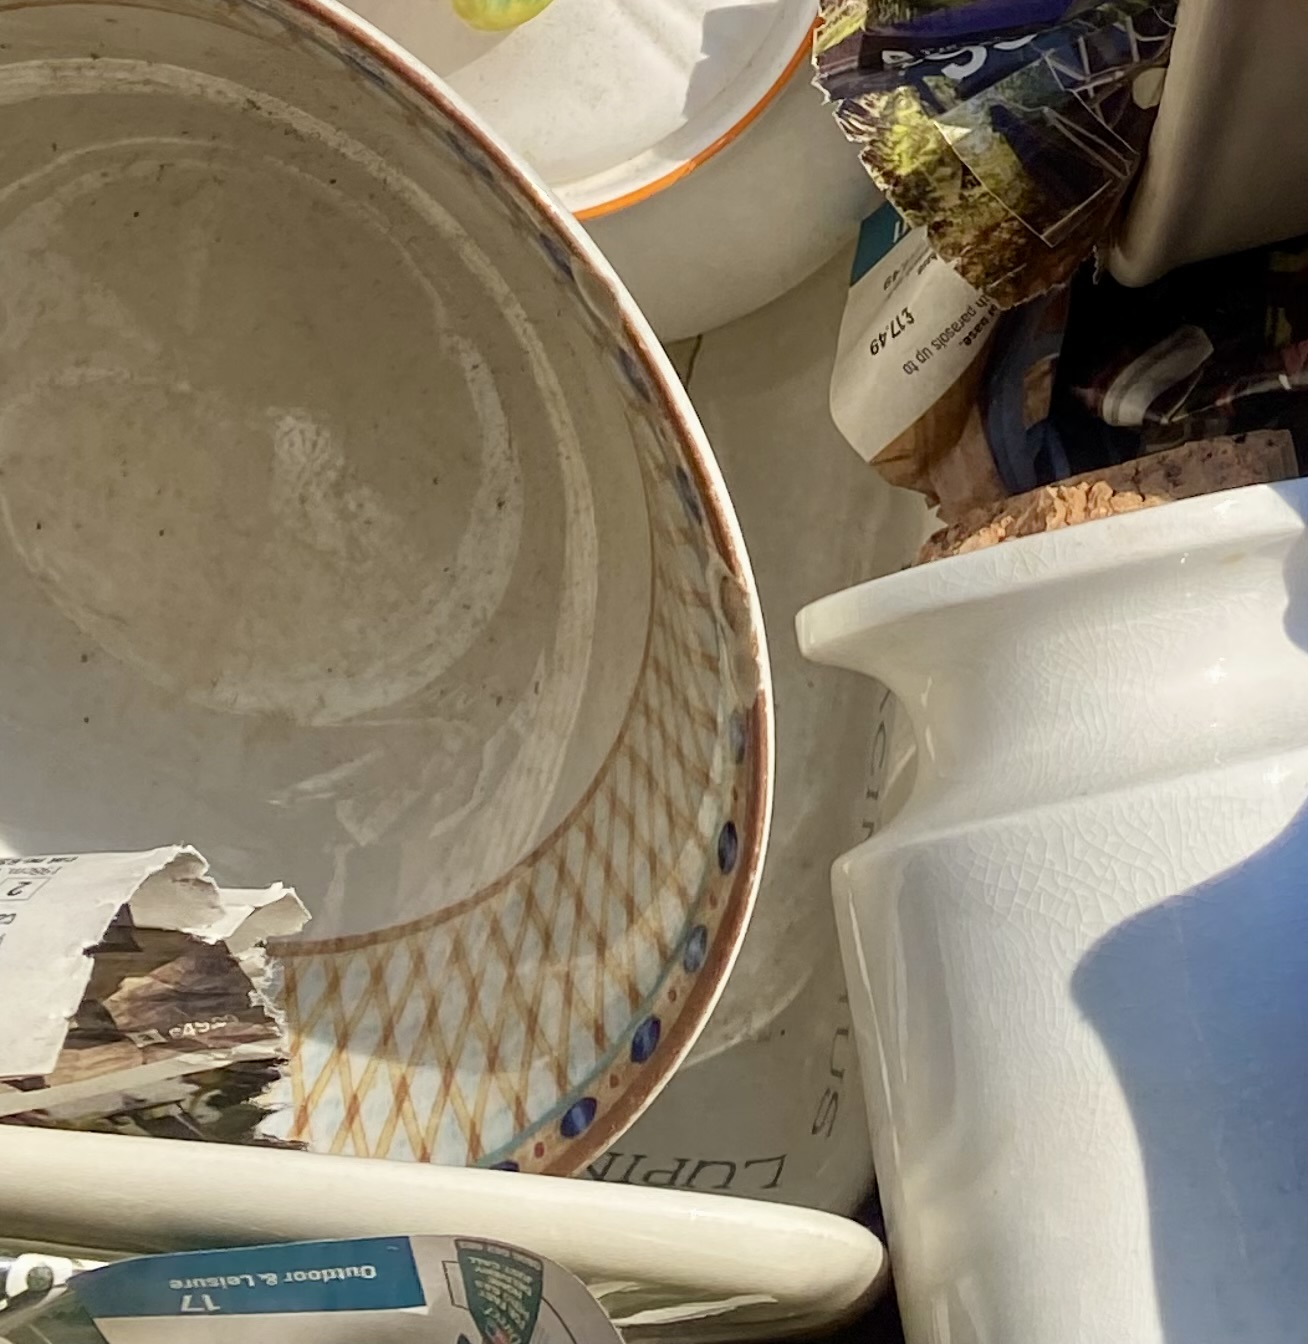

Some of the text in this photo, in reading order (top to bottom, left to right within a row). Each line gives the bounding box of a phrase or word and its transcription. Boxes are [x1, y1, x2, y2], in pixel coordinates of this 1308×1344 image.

[870, 306, 915, 356] £17.49
[931, 305, 977, 350] parasols
[915, 346, 934, 364] up
[902, 361, 920, 375] to
[168, 1265, 378, 1290] Outdoor & Leisure
[180, 1293, 221, 1312] 17
